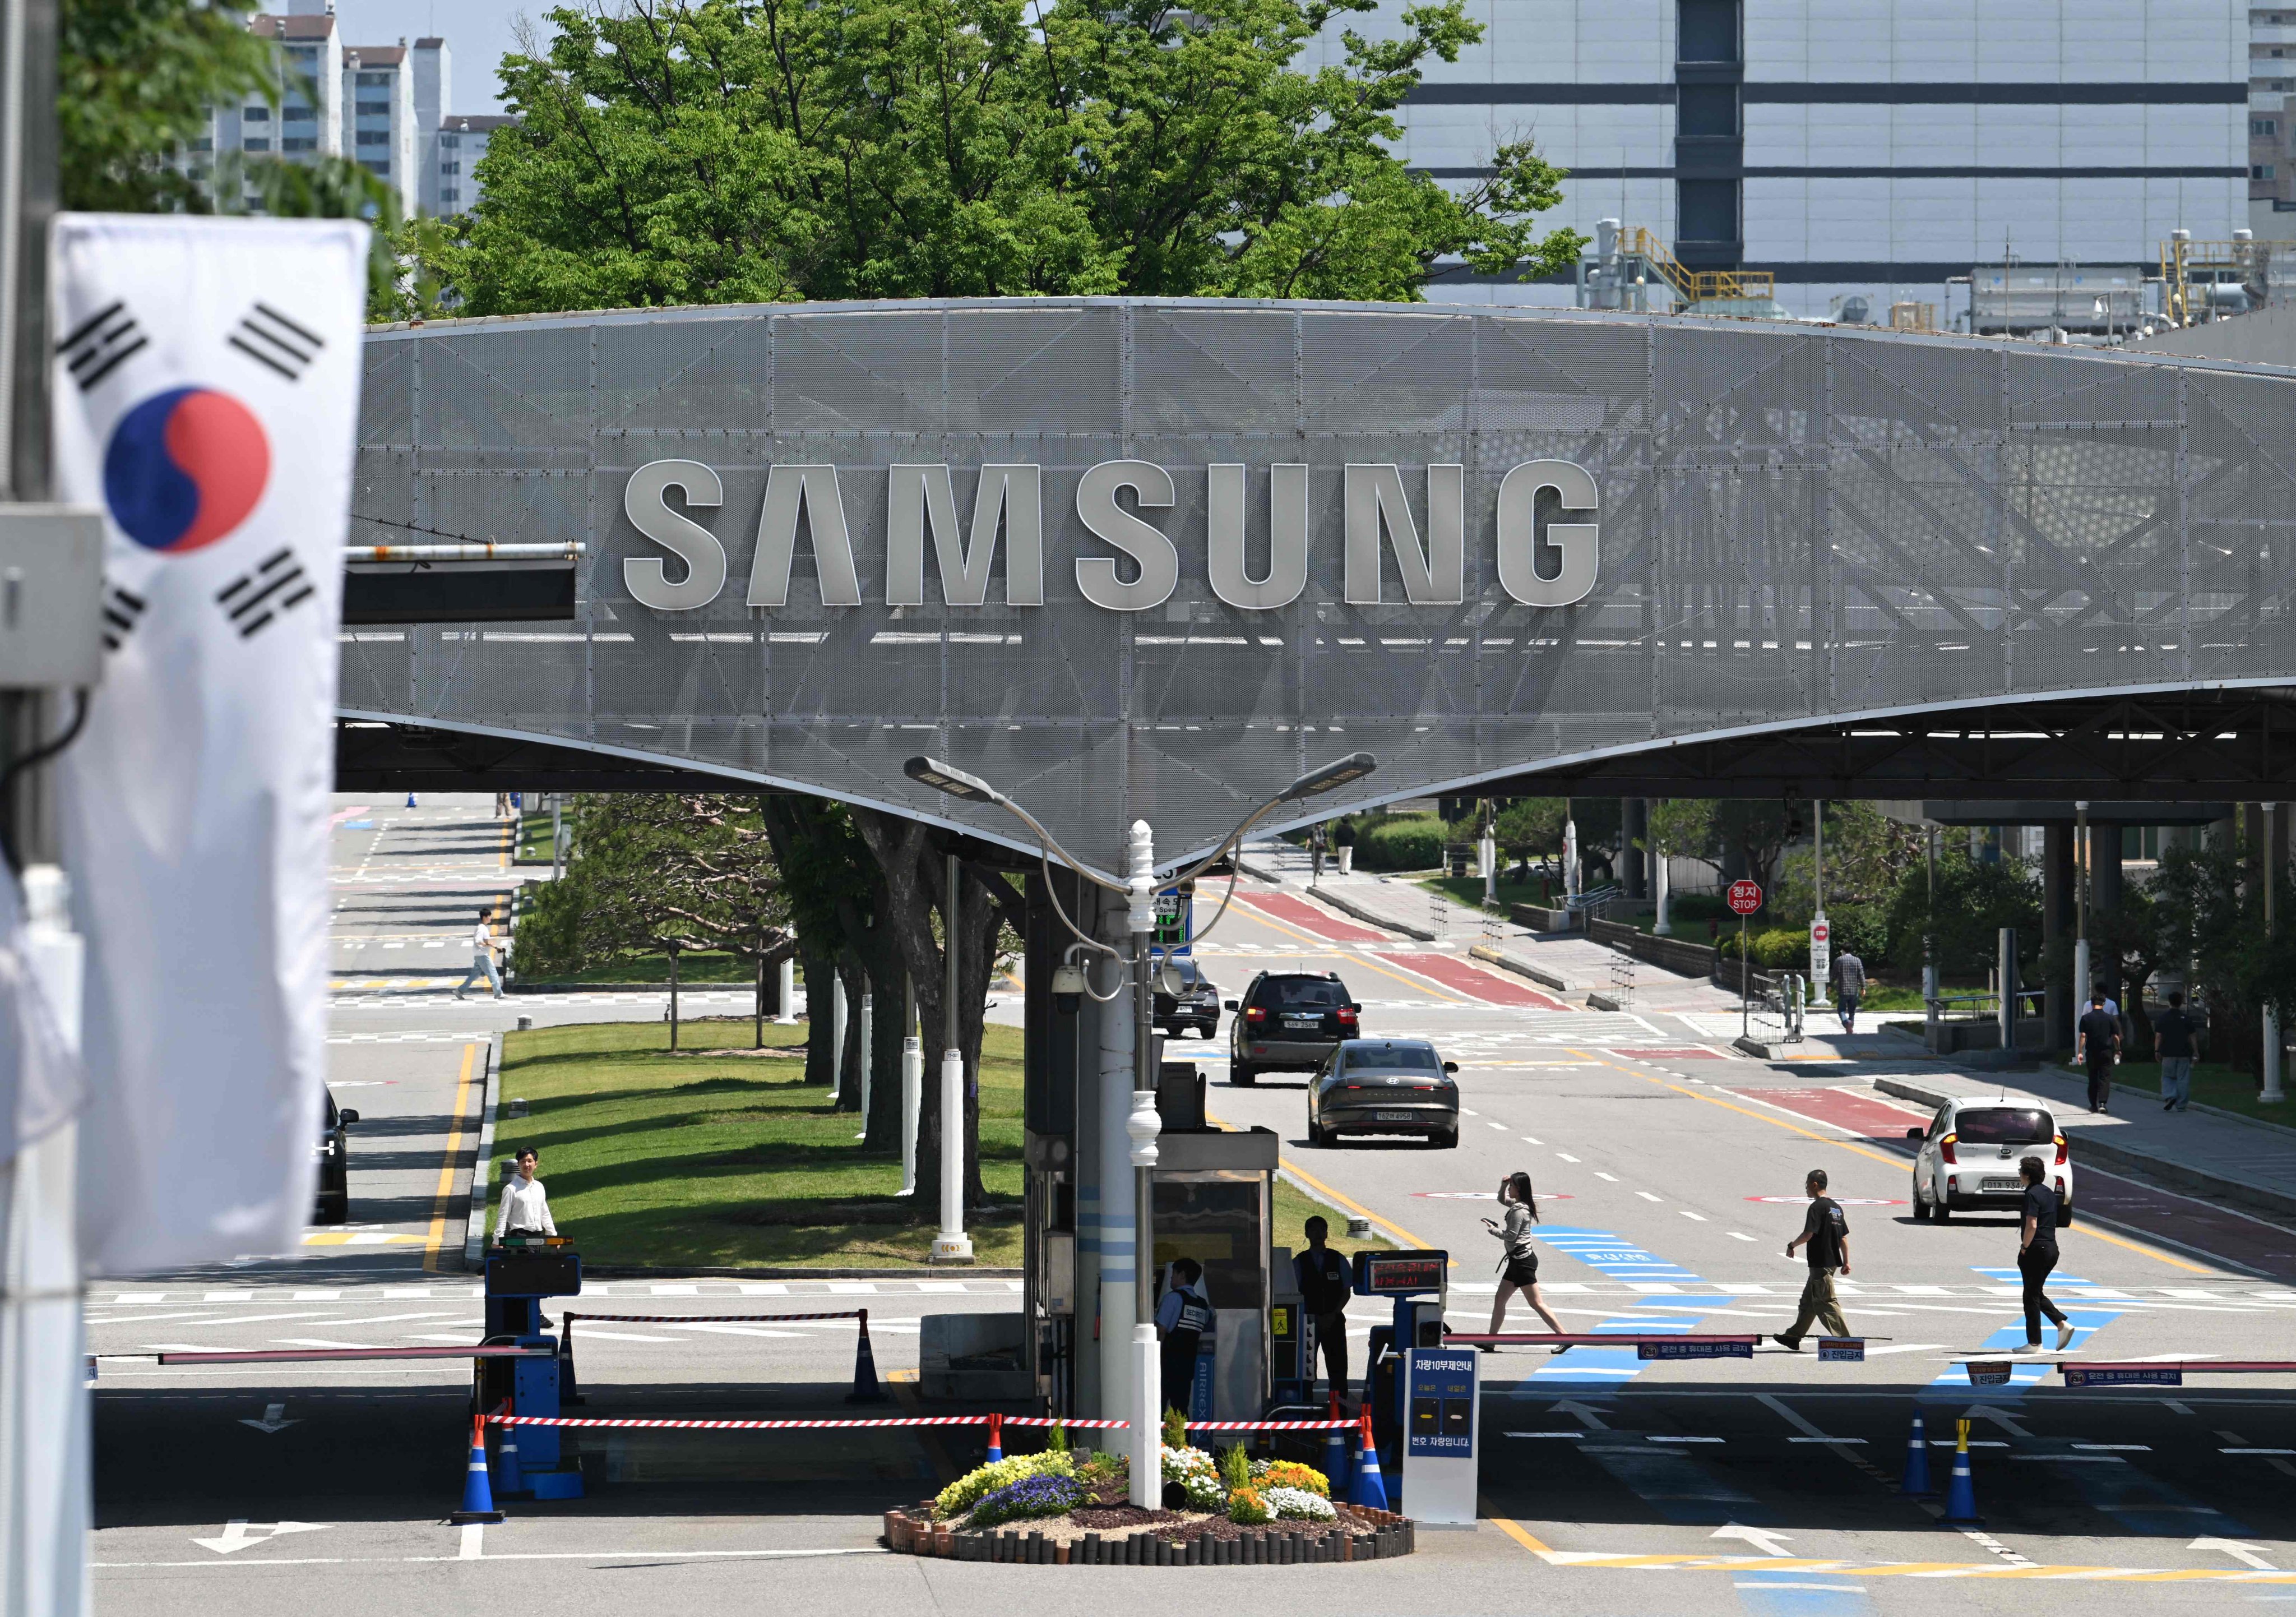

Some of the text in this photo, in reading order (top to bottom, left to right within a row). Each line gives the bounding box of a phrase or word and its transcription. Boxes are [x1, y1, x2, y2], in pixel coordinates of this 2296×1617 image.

[623, 459, 1600, 610] SAMSUNG
[1732, 886, 1756, 898] 정지
[1733, 900, 1757, 909] STOP
[1831, 1350, 1863, 1360] 진입금지
[1415, 1360, 1472, 1371] 차량10부제안내
[1979, 1373, 2010, 1384] 진입금지
[1198, 1362, 1207, 1418] AIRREX
[1412, 1436, 1427, 1446] 번호
